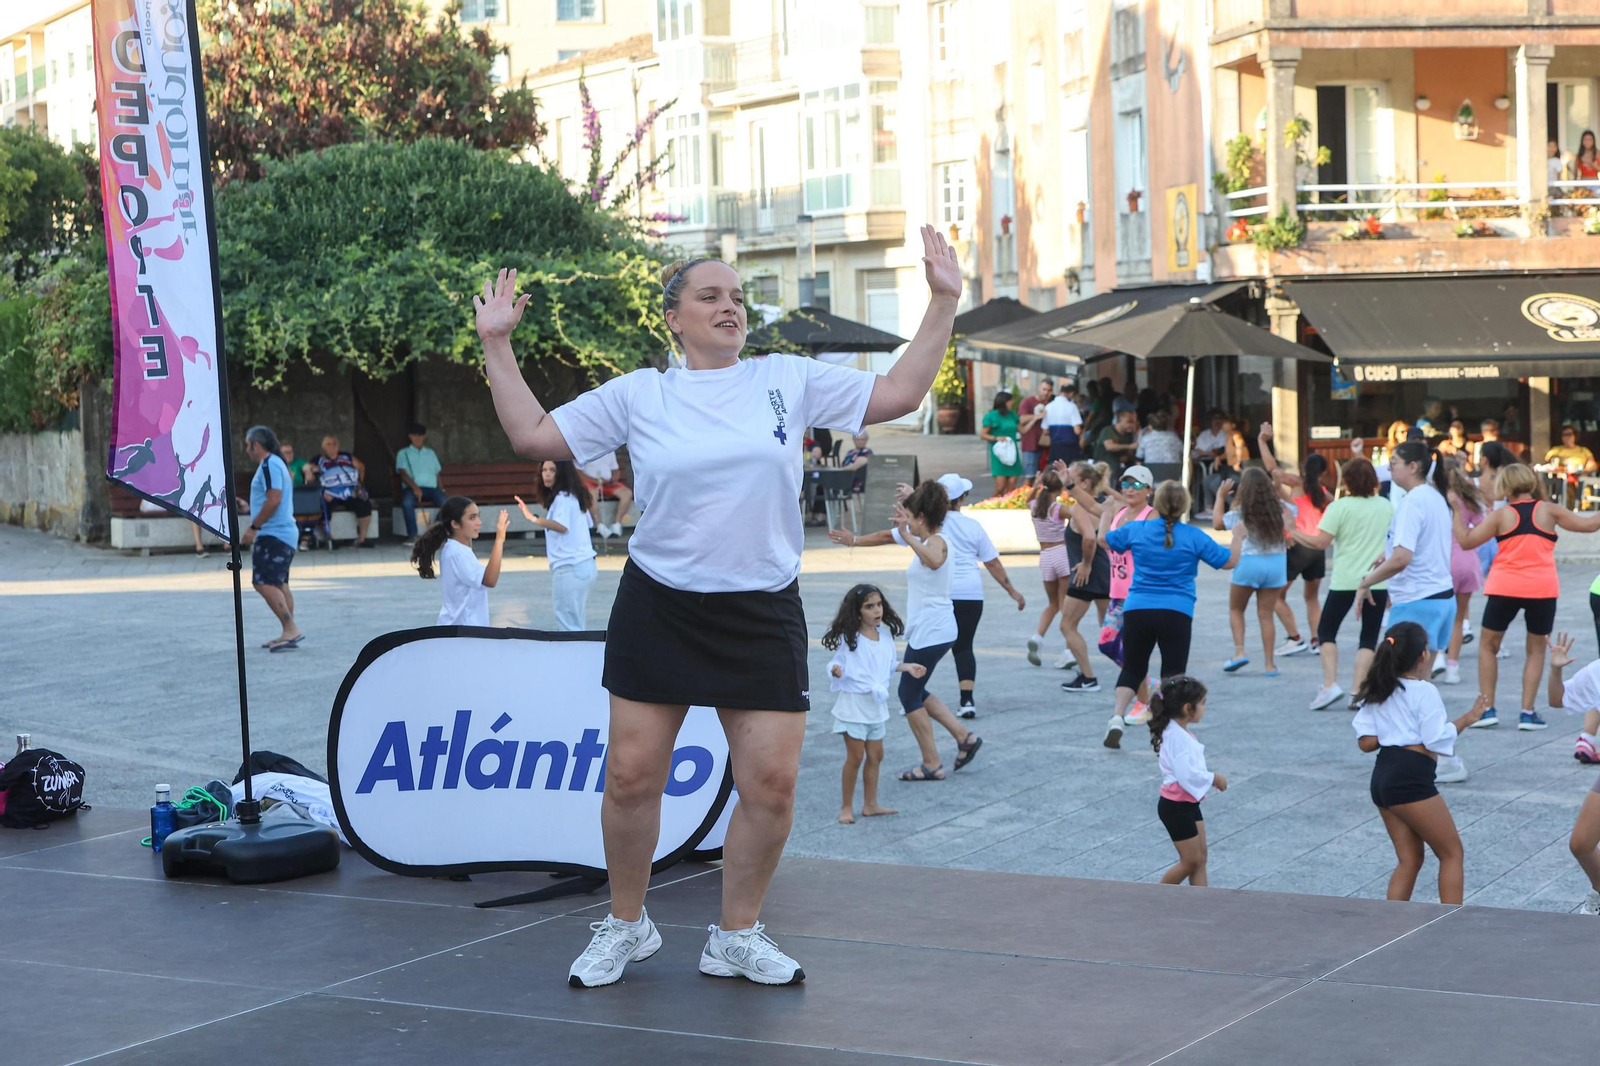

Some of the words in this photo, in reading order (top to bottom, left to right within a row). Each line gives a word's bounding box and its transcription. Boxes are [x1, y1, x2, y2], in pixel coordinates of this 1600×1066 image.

[1354, 365, 1364, 381] O
[1364, 365, 1397, 381] CUCO
[768, 389, 785, 428] DEPORTE
[355, 709, 714, 797] Atlánto
[41, 770, 80, 792] ZUMBA
